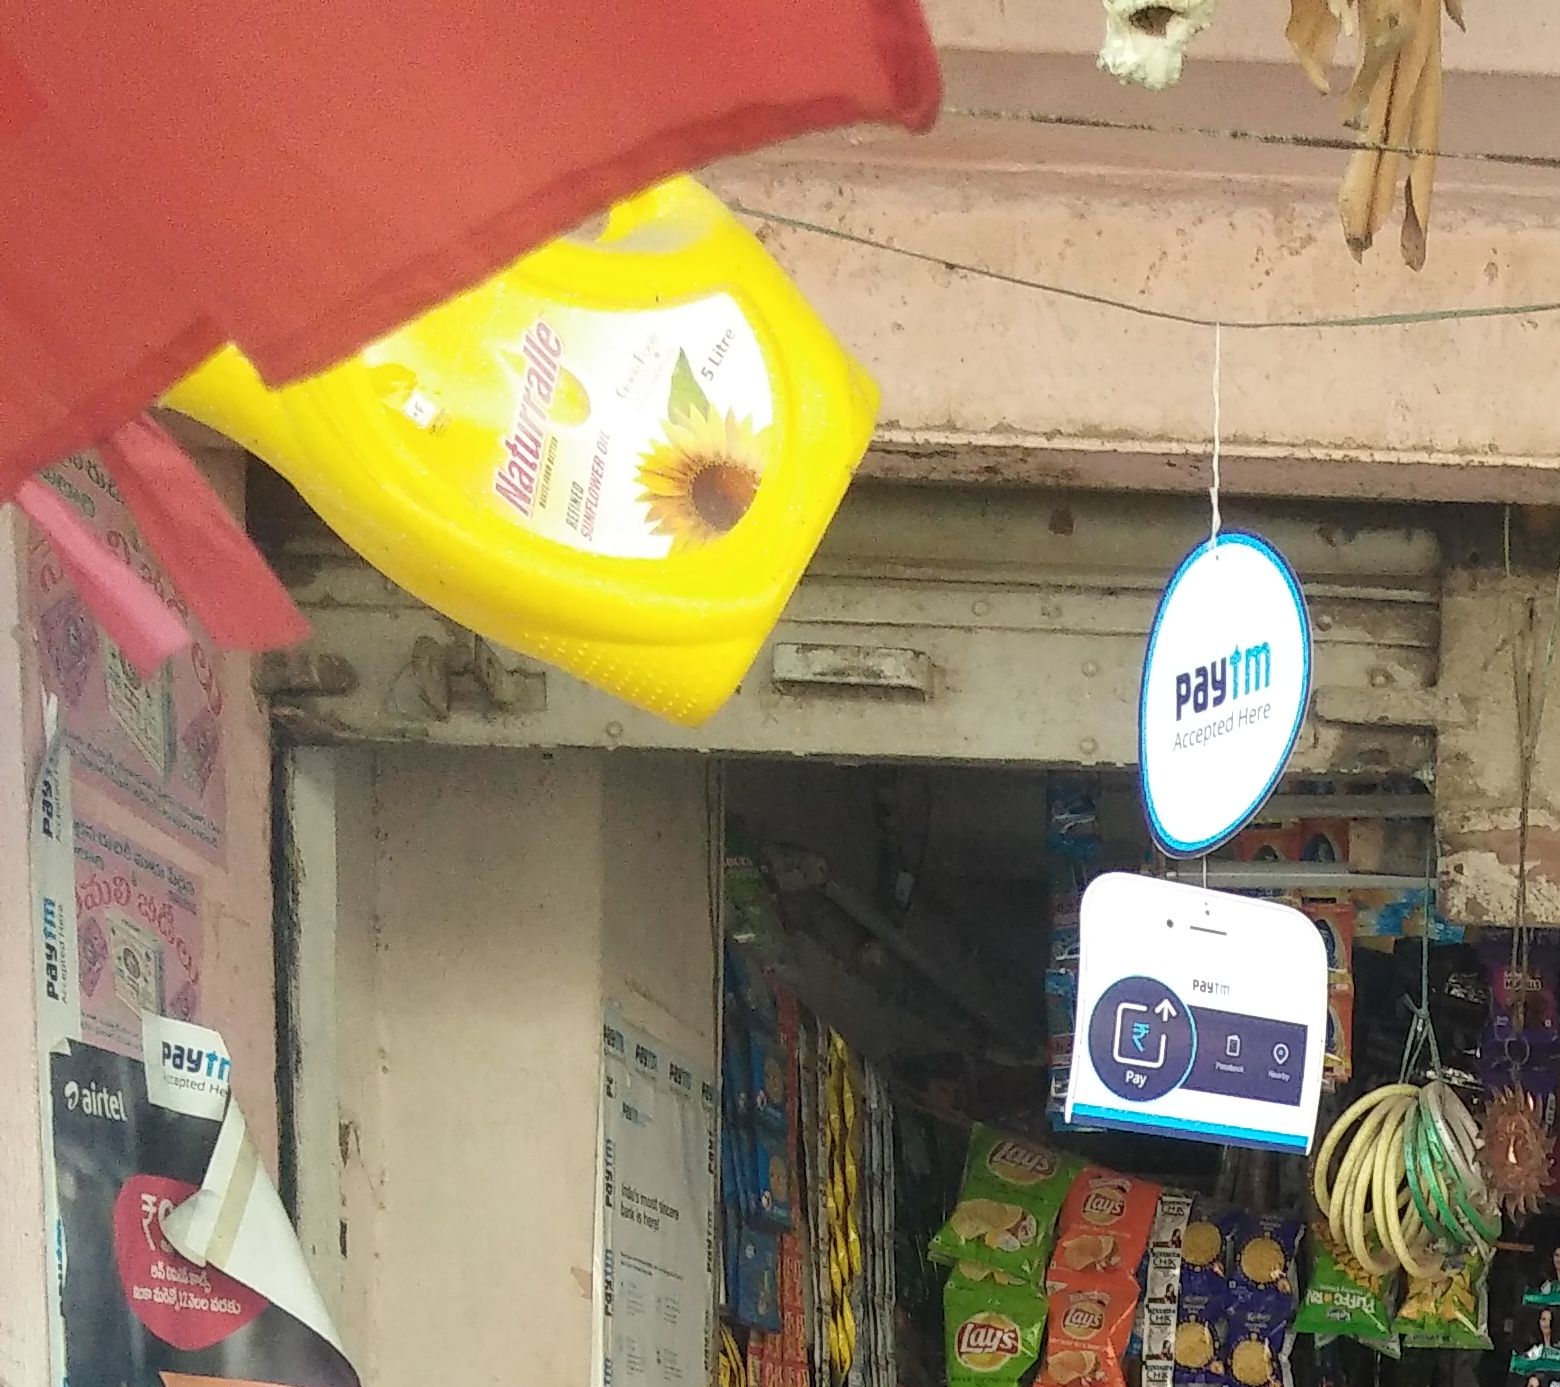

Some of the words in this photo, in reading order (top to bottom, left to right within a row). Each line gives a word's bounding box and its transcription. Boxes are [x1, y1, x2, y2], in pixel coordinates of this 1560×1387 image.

[701, 366, 715, 382] 5
[711, 326, 737, 368] Litre
[494, 321, 563, 518] Naturralle
[565, 480, 585, 531] REFINED
[580, 454, 605, 542] SUNFLOWER
[597, 429, 611, 456] OIL
[1174, 640, 1272, 721] Paytm
[1173, 712, 1234, 752] Accepted
[1239, 700, 1272, 730] Here
[81, 1083, 128, 1122] airtel
[1125, 1068, 1147, 1089] Pay
[961, 1323, 1018, 1354] Lay's
[1063, 1306, 1102, 1329] Lay's
